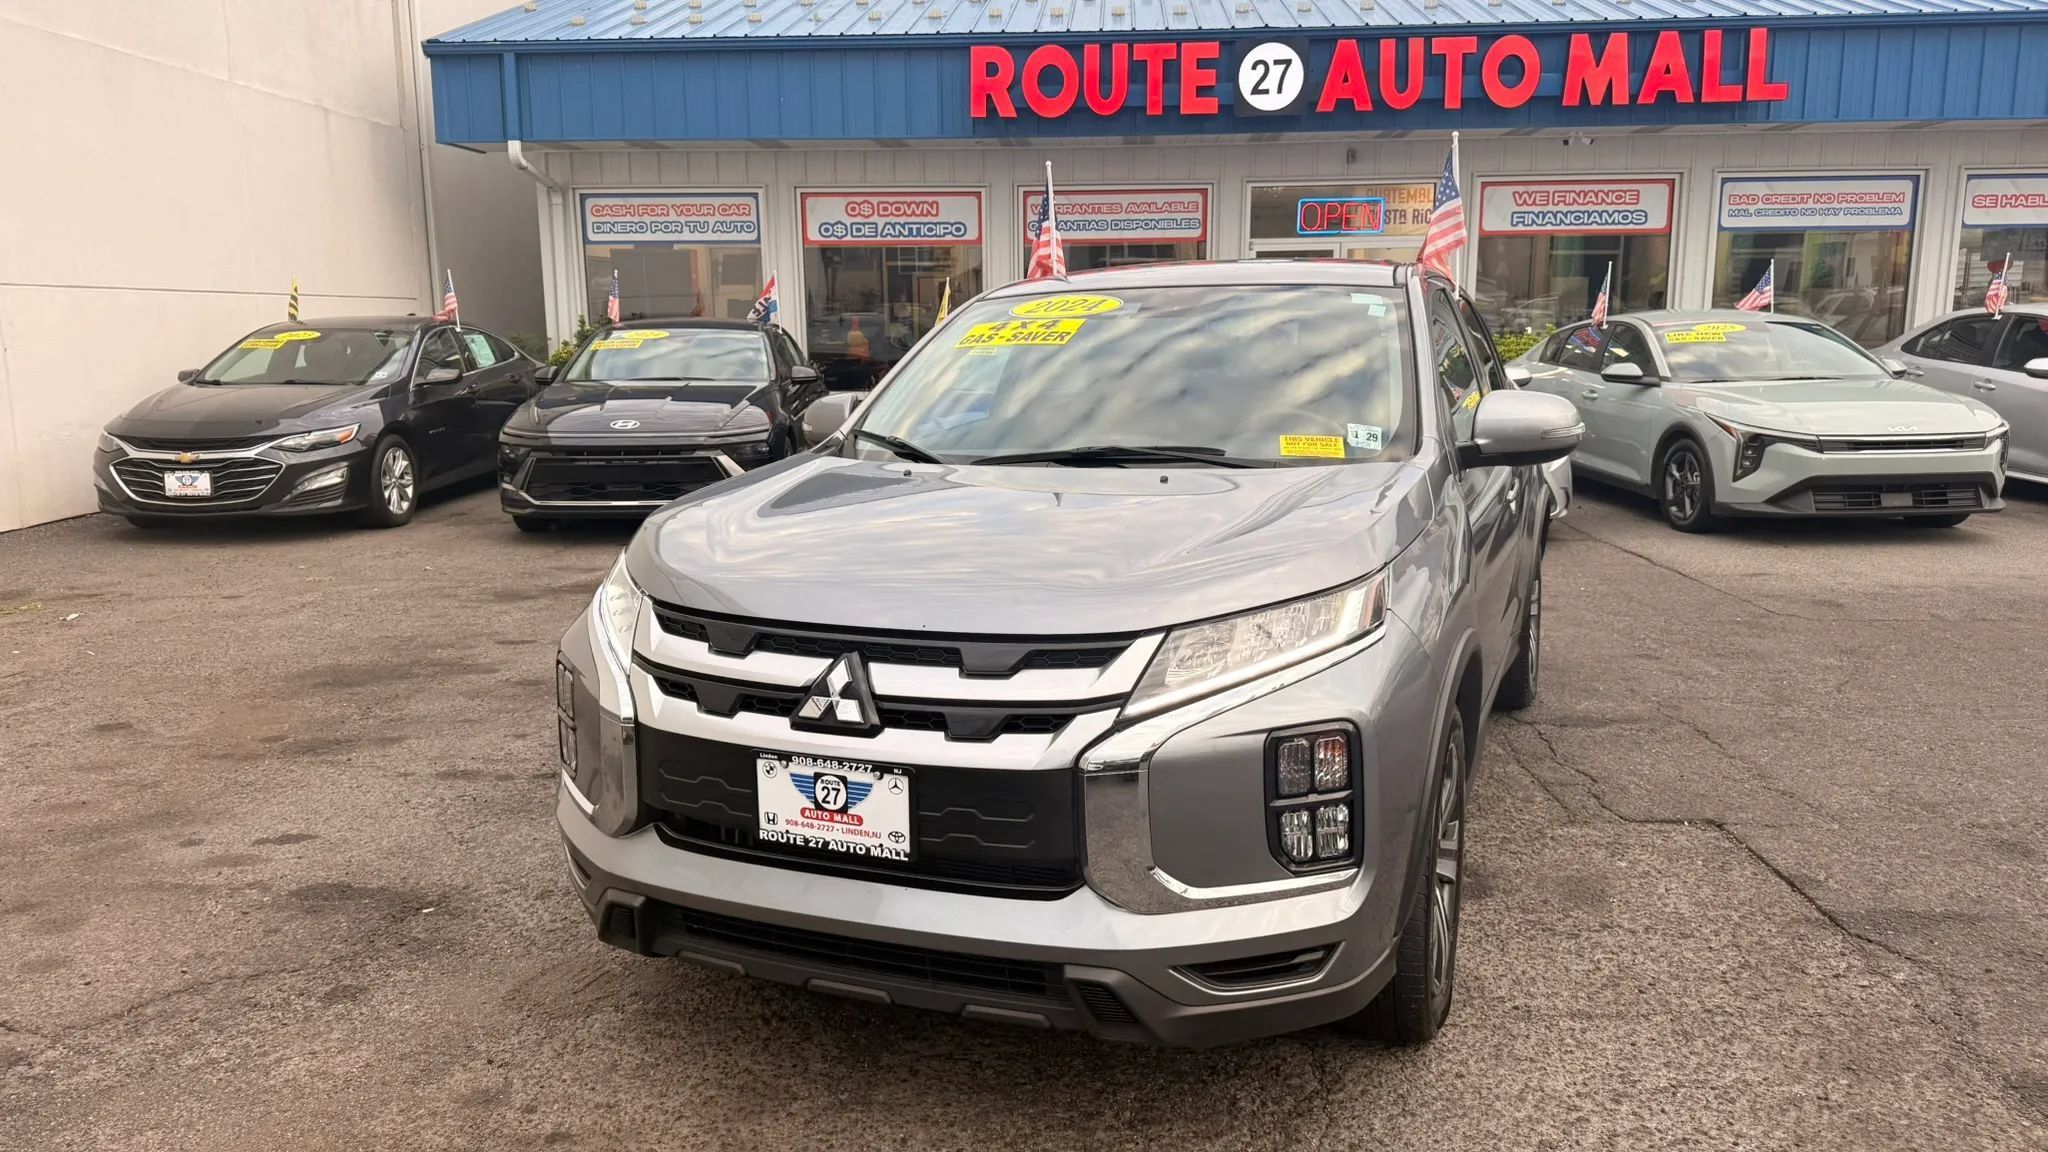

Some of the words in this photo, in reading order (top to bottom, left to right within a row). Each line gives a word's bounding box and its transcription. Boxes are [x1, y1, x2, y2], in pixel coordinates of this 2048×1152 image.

[970, 41, 1219, 118] ROUTE
[1250, 59, 1292, 95] 27
[1316, 34, 1541, 112] AUTO
[1562, 27, 1788, 106] MALL
[1513, 190, 1548, 206] WE
[1552, 190, 1639, 206] FINANCE
[1728, 193, 1759, 205] BAD
[1761, 193, 1811, 205] CREDIT
[1813, 193, 1834, 204] NO
[1836, 192, 1905, 204] PROBLEM
[1972, 195, 1998, 208] SE
[591, 204, 634, 216] CASH
[637, 204, 669, 216] FOR
[672, 203, 715, 216] YOUR
[717, 203, 751, 216] CAR
[877, 202, 939, 217] DOWN
[1031, 202, 1123, 215] WRRANTIES
[1125, 201, 1199, 214] AVAILABLE
[1728, 208, 1752, 217] MAL
[1754, 208, 1799, 217] CREDITO
[1800, 208, 1817, 216] NO
[1819, 207, 1842, 216] HAY
[1843, 207, 1902, 216] PROBLEMA
[1301, 202, 1382, 231] OPEN
[1511, 210, 1648, 226] FINANCIAMOS
[592, 221, 648, 234] DINERO
[650, 221, 683, 233] POR
[685, 221, 708, 233] TU
[712, 220, 756, 233] AUTO
[850, 222, 879, 238] DE
[880, 222, 967, 238] ANTICIPO
[1028, 219, 1109, 231] GANTIAS
[1110, 218, 1201, 231] DISPONIBLES
[1024, 299, 1108, 315] 2024
[1366, 432, 1378, 442] 29
[760, 752, 778, 760] Linden
[792, 756, 873, 774] 908-648-2727
[820, 779, 841, 787] ROUTE
[821, 786, 841, 806] 27
[804, 809, 830, 821] AUTO
[833, 813, 860, 824] MALL
[784, 818, 835, 833] 908-648-2727
[760, 829, 806, 846] ROUTE
[808, 837, 825, 849] 27
[828, 840, 866, 855] AUTO
[870, 846, 909, 861] MALL
